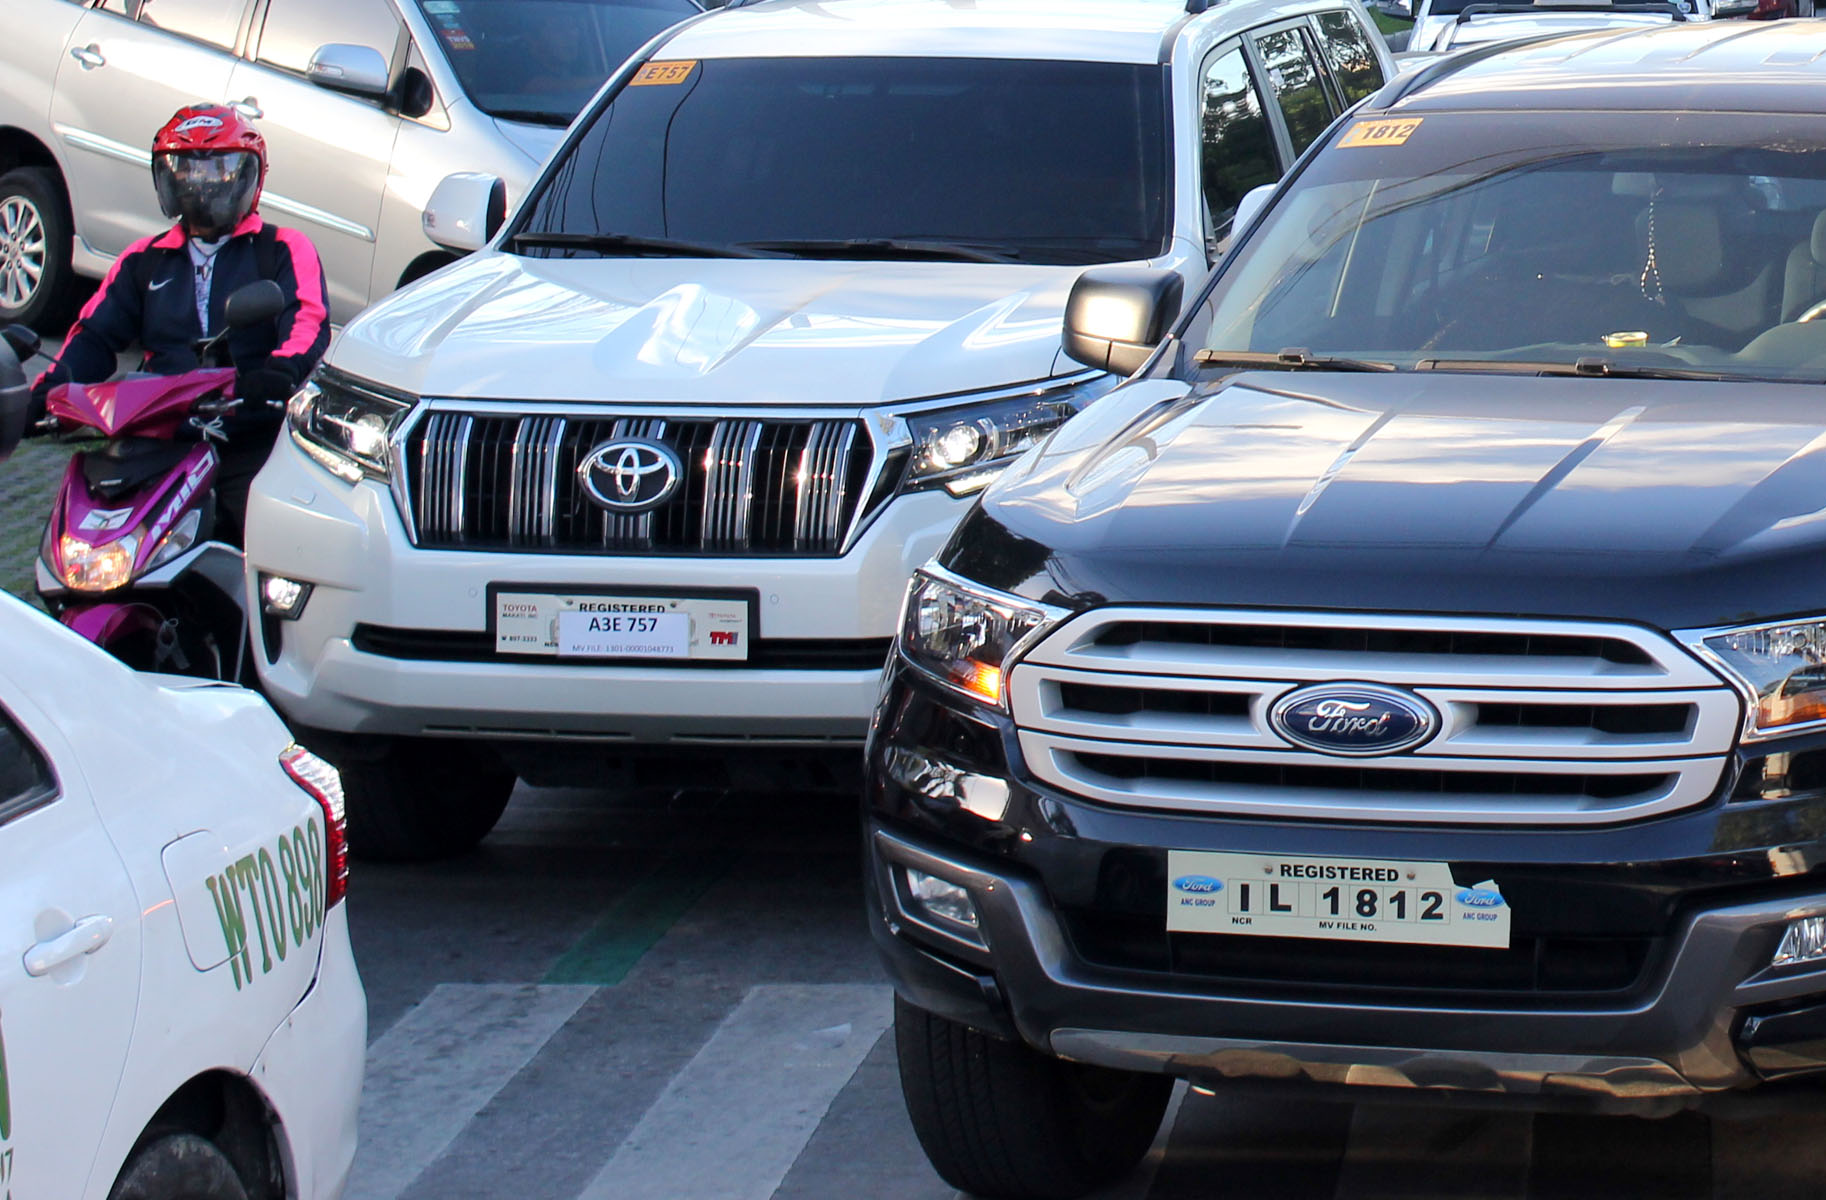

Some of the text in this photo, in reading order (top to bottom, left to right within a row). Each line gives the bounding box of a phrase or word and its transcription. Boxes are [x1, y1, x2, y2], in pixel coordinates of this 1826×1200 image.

[645, 66, 689, 79] E757
[1362, 123, 1416, 140] 1812
[503, 604, 537, 612] TOYOTA
[579, 603, 666, 613] REGISTERED
[589, 617, 658, 632] A3E 757
[1308, 699, 1391, 736] Ford
[1280, 863, 1399, 882] REGISTERED
[1182, 877, 1214, 893] Ford
[1181, 898, 1216, 907] ANC GROUP
[1323, 886, 1444, 920] 1812
[1464, 890, 1496, 906] Ford
[1231, 917, 1252, 925] NCR
[1463, 912, 1498, 921] ANC GROUP
[1319, 921, 1377, 931] MV FILE NO.
